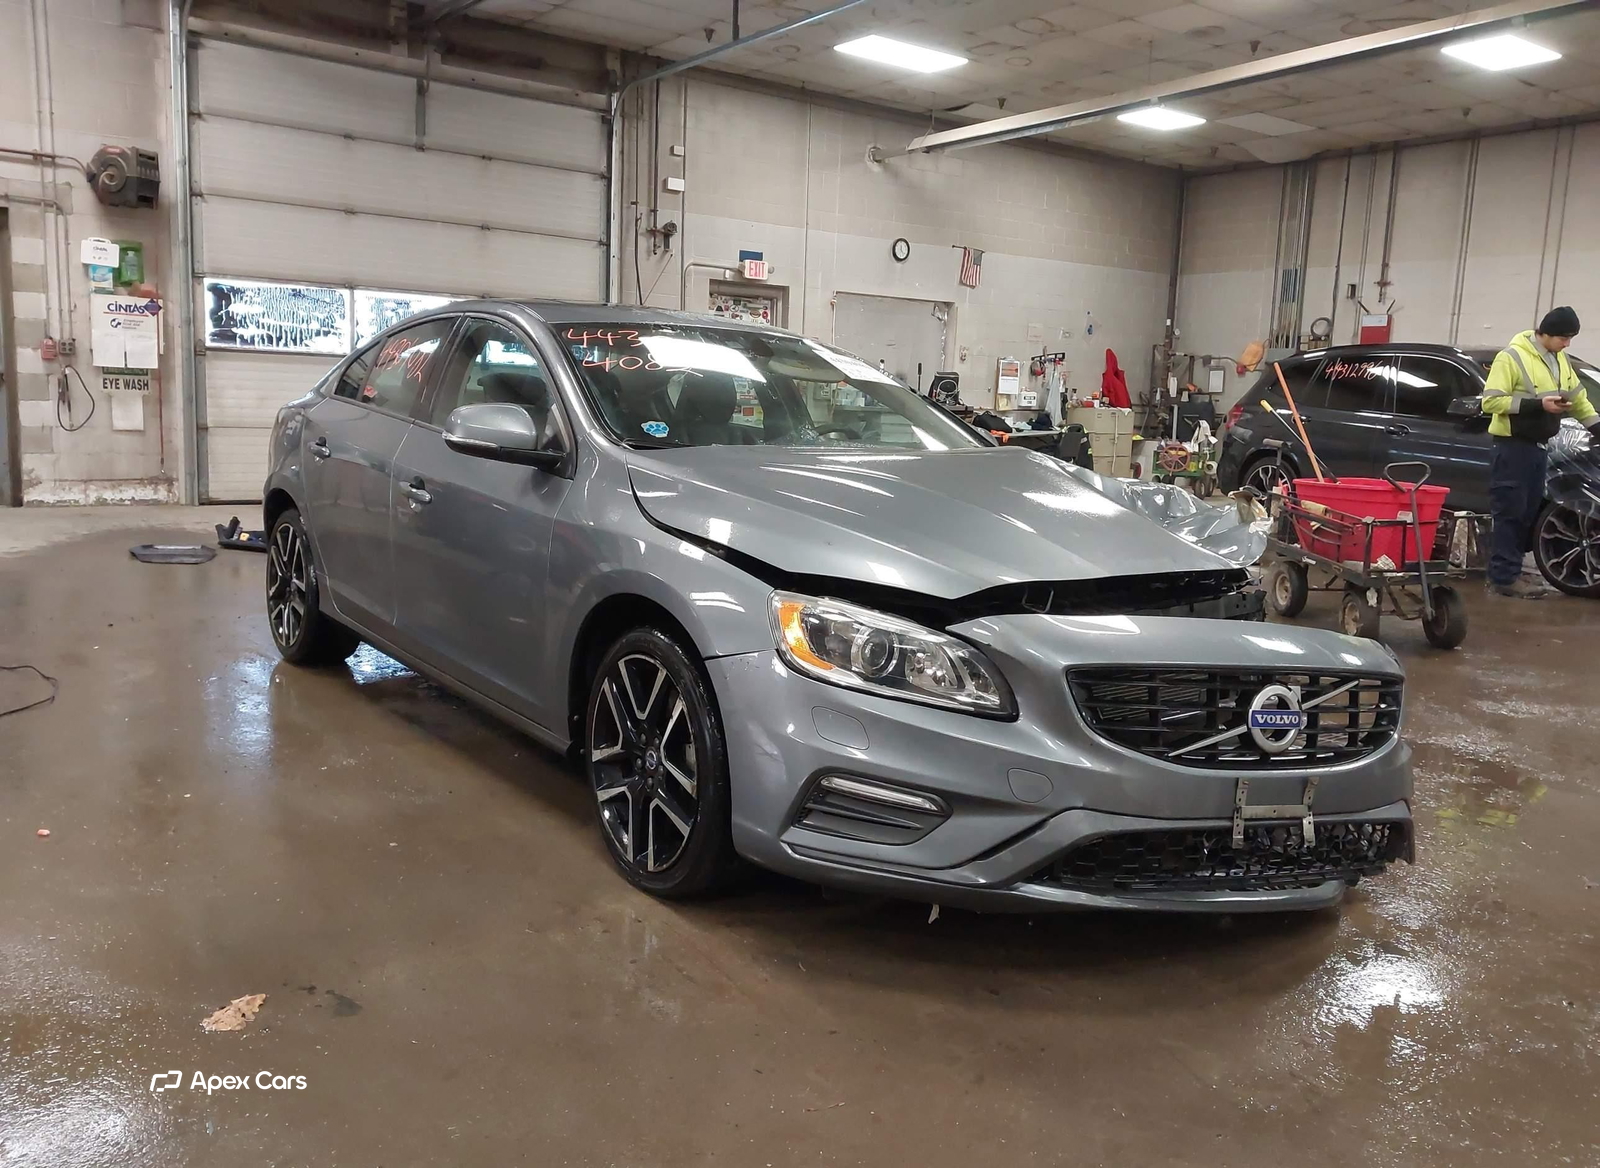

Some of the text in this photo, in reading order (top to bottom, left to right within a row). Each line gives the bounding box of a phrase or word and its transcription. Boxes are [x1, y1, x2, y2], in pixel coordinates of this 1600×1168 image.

[749, 261, 766, 278] EXIT
[102, 377, 149, 391] EYE WASH
[1254, 714, 1299, 724] VOLVO
